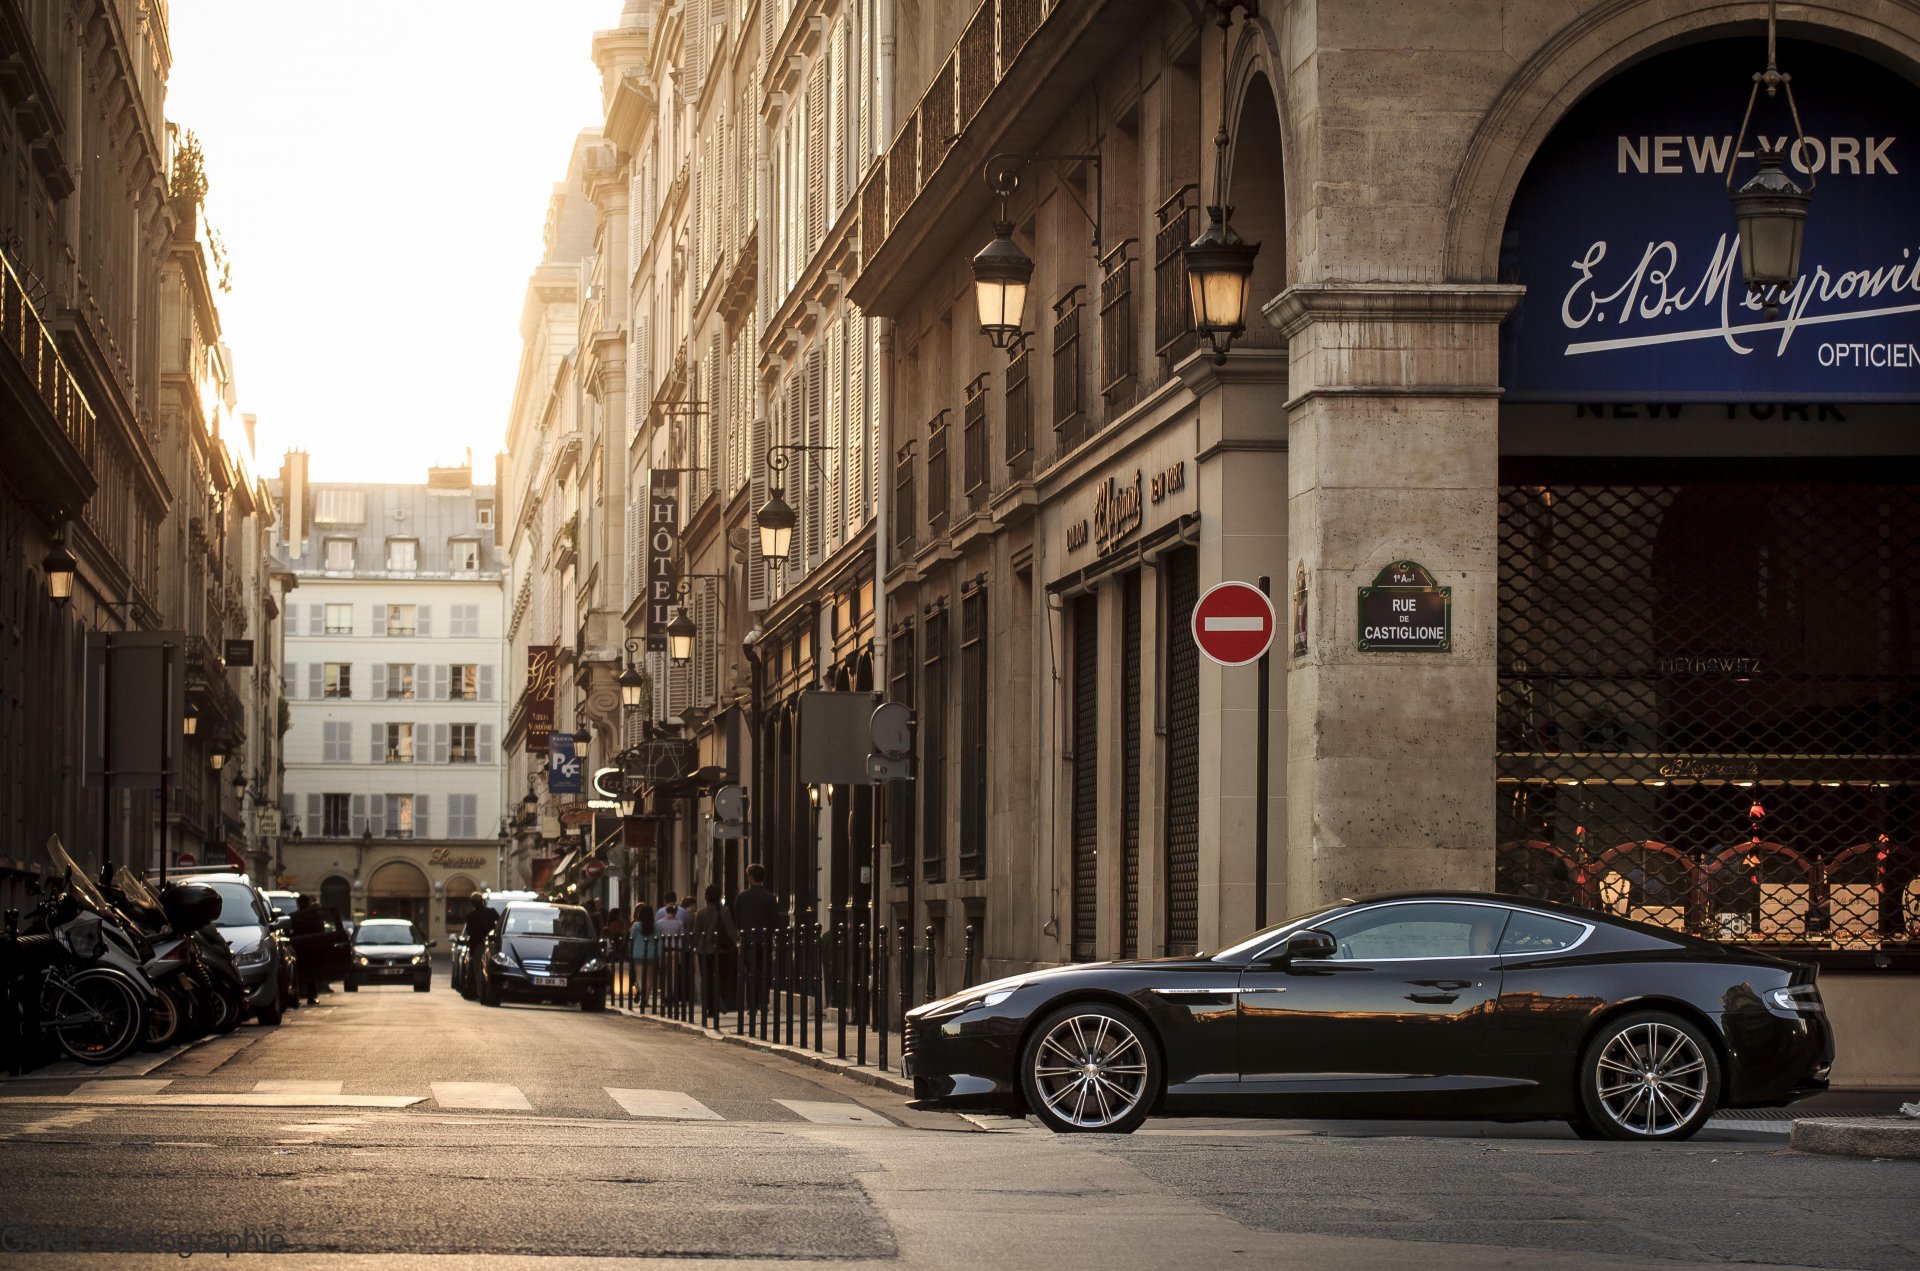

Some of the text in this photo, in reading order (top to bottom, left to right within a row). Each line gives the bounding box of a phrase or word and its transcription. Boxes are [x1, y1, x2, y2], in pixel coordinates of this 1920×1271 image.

[1166, 461, 1185, 495] YORK
[653, 504, 674, 624] HÔTEL
[1392, 599, 1417, 612] RUE
[1400, 615, 1410, 623] DE
[1364, 626, 1444, 640] CASTIGLIONE
[552, 753, 566, 770] P
